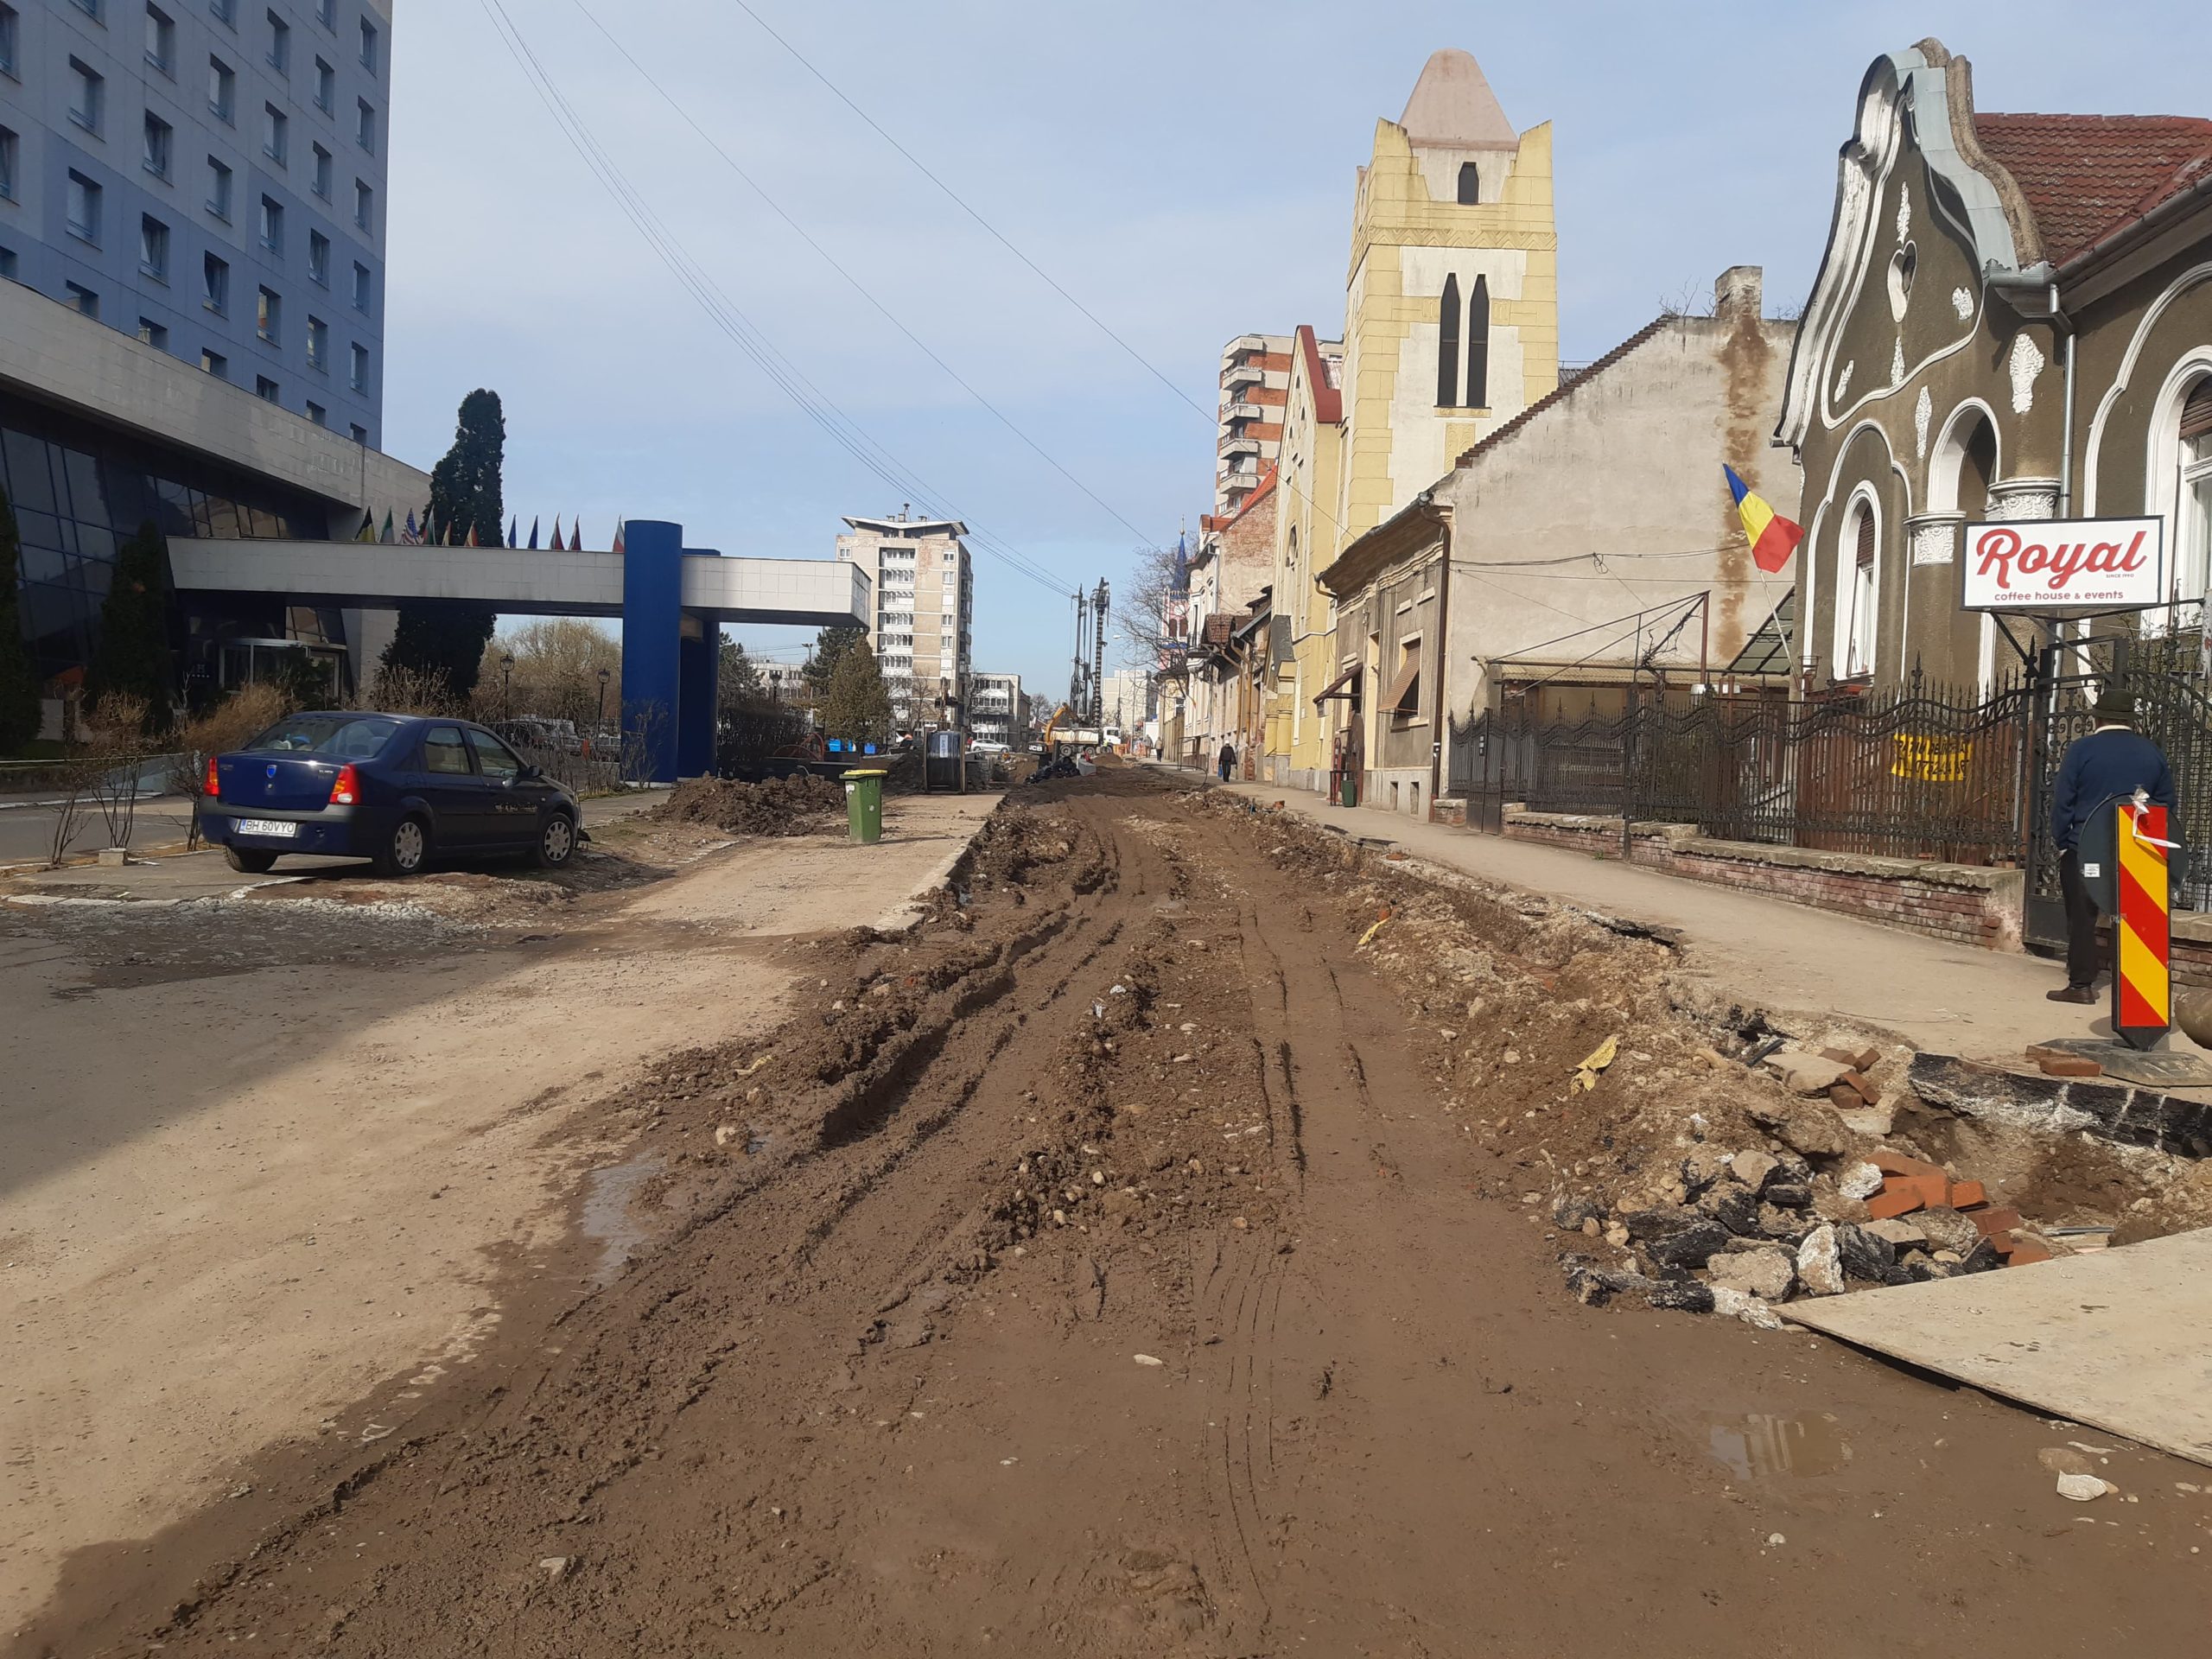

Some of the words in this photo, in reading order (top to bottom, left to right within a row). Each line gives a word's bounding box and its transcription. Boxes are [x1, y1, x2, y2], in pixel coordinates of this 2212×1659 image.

[1976, 528, 2147, 590] Royal
[1994, 591, 2031, 601] coffee
[2035, 591, 2070, 601] house
[2084, 590, 2124, 600] events
[245, 820, 260, 830] BH
